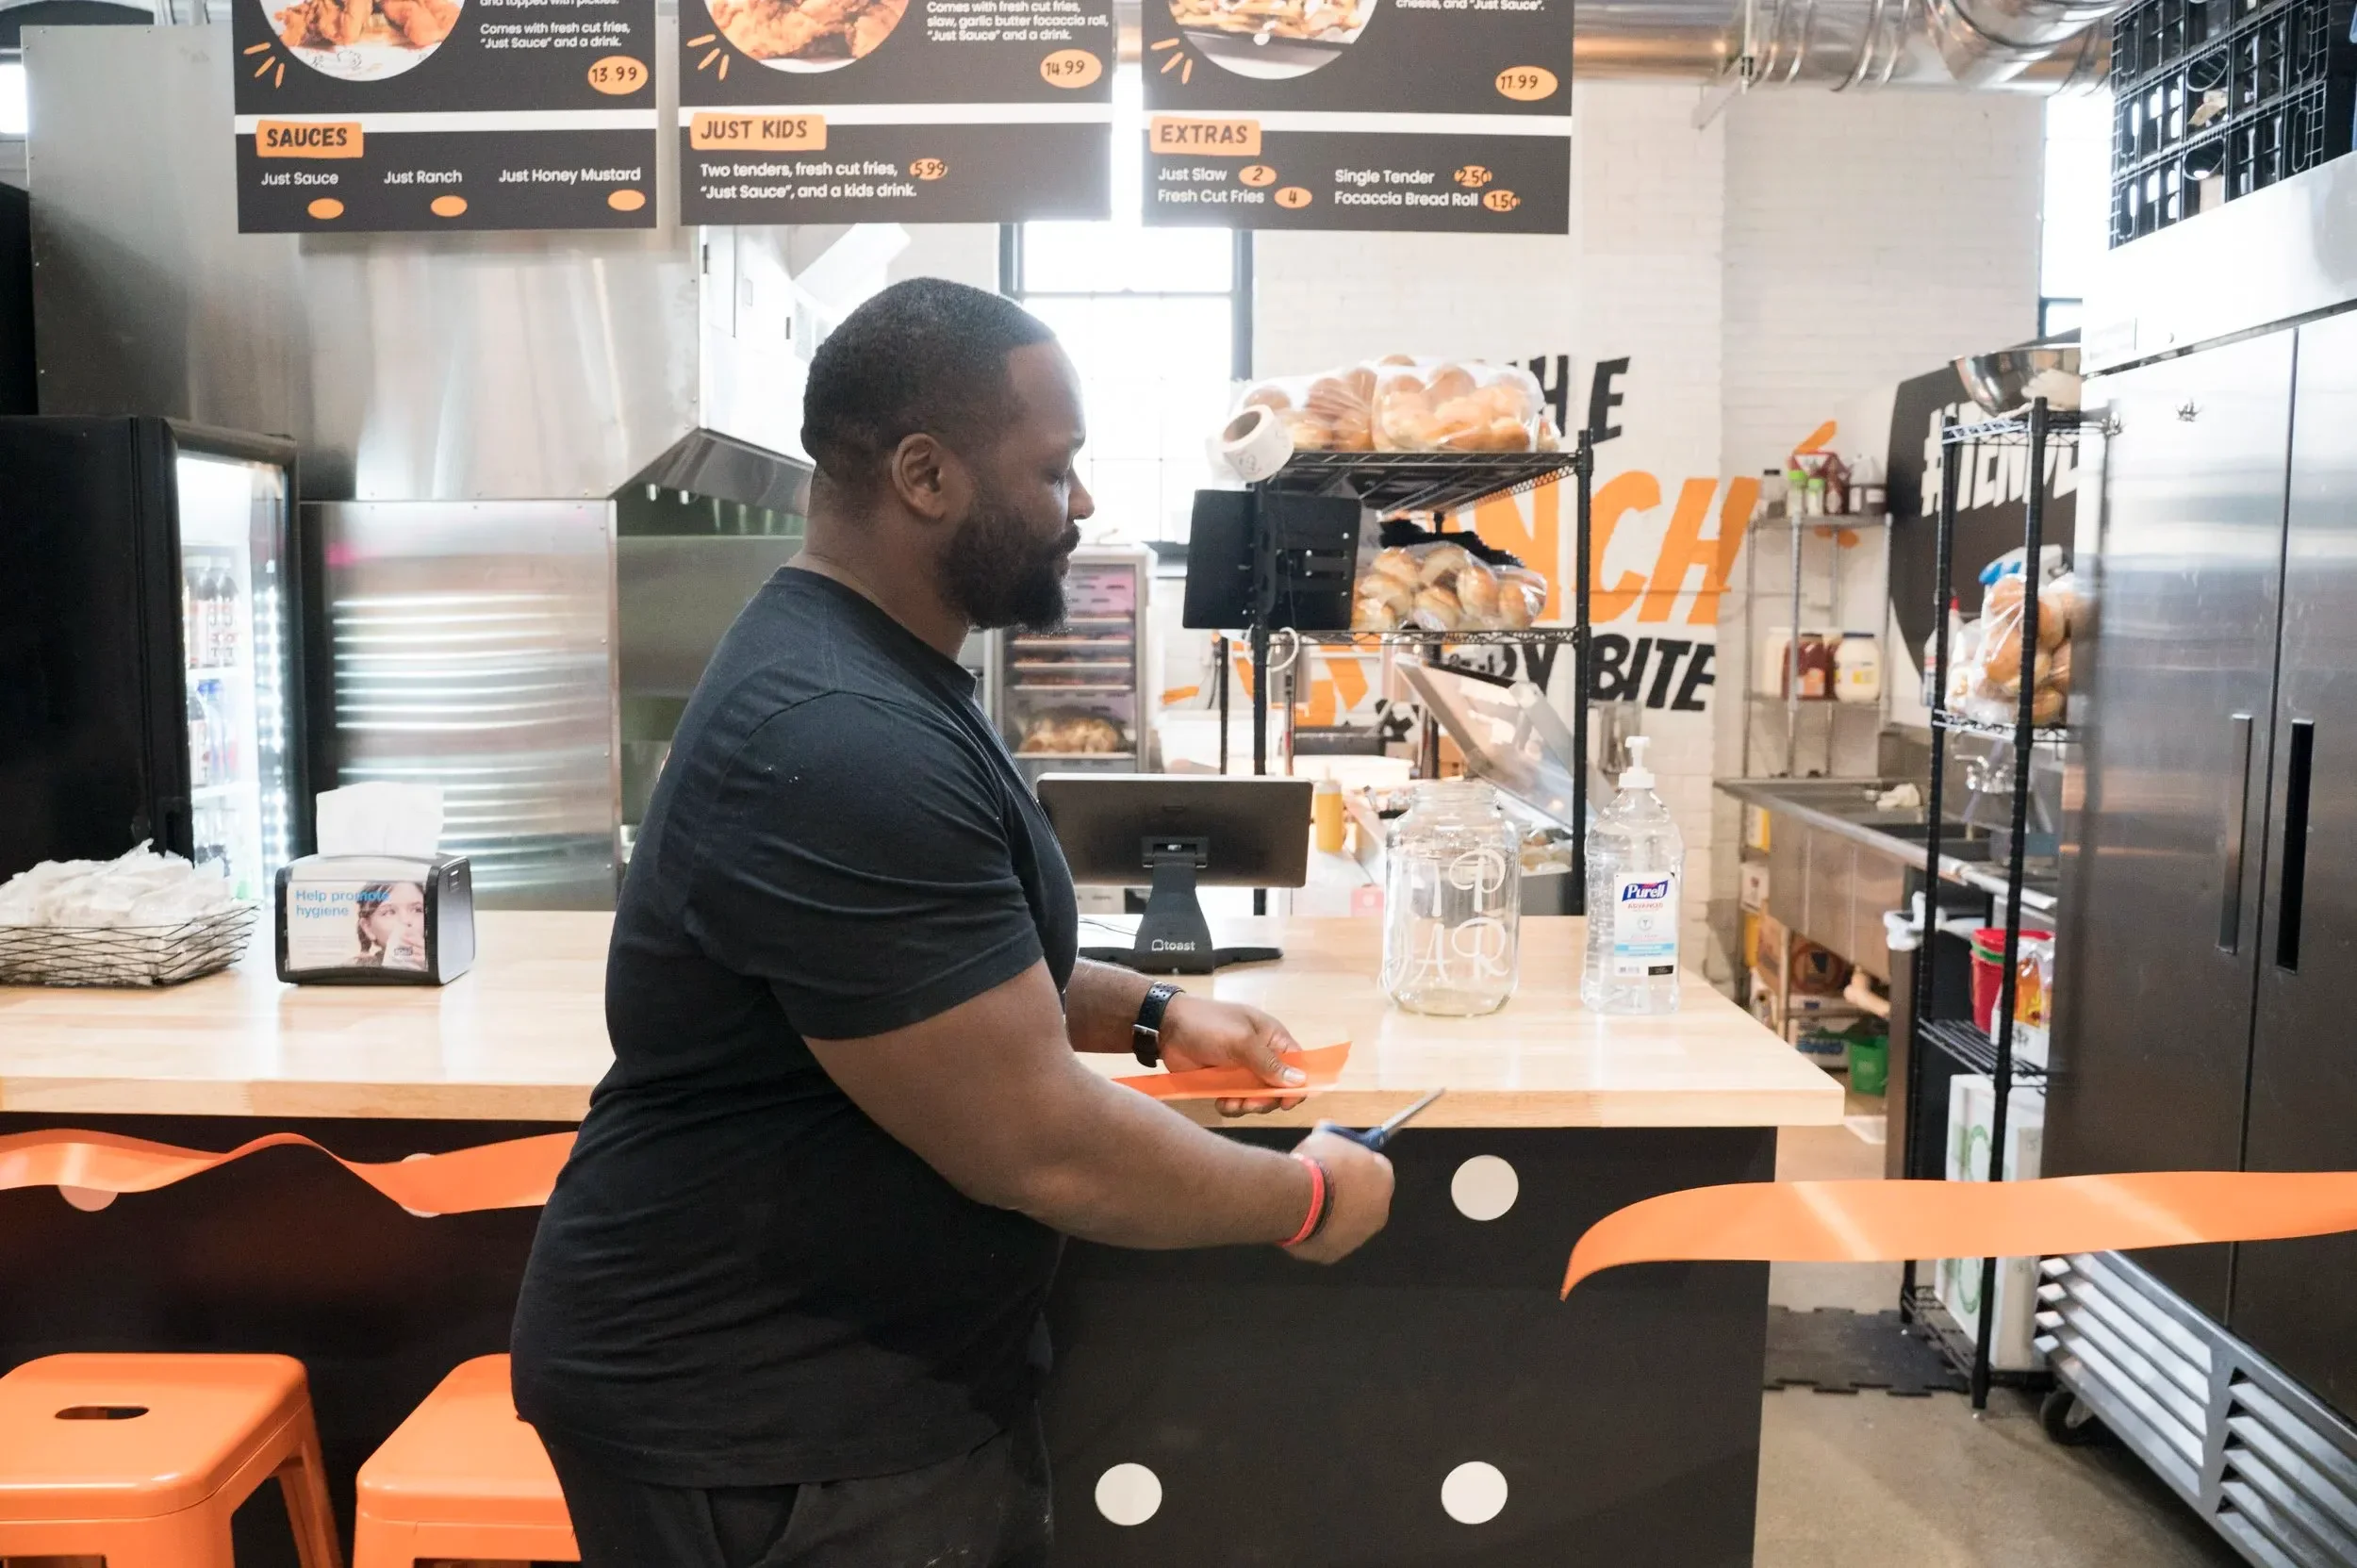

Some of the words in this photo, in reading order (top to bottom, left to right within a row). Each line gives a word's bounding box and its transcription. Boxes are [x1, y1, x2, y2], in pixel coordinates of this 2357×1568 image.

[927, 1, 970, 12] Comes
[972, 1, 997, 12] with
[998, 1, 1029, 12] fresh
[1031, 2, 1051, 12] cut
[1052, 0, 1080, 13] fries,
[1442, 0, 1468, 8] and
[480, 24, 521, 34] Comes
[524, 23, 548, 33] with
[551, 22, 580, 33] fresh
[582, 23, 602, 33] cut
[602, 21, 631, 34] fries,
[927, 16, 957, 27] slaw,
[959, 15, 993, 29] garlic
[995, 15, 1031, 26] butter
[1033, 14, 1086, 26] focaccia
[1087, 14, 1109, 27] roll,
[480, 38, 508, 48] "Just
[511, 37, 552, 48] Sauce"
[554, 36, 577, 47] and
[580, 39, 588, 47] a
[590, 36, 622, 47] drink.
[927, 30, 957, 41] "Just
[959, 29, 1000, 41] Sauce"
[1002, 29, 1027, 41] and
[1029, 32, 1038, 41] a
[1039, 28, 1072, 41] drink.
[592, 66, 637, 83] 13.99
[266, 127, 348, 147] SAUCES
[701, 120, 753, 140] JUST
[762, 120, 808, 139] KIDS
[1161, 124, 1248, 144] EXTRAS
[499, 169, 529, 183] Just
[532, 169, 578, 186] Honey
[581, 167, 641, 182] Mustard
[700, 163, 731, 177] Two
[733, 162, 793, 177] tenders,
[795, 161, 832, 176] fresh
[835, 162, 861, 176] cut
[863, 161, 898, 177] fries,
[1158, 168, 1190, 182] Just
[1192, 167, 1228, 182] Slaw
[1252, 167, 1263, 181] 2
[261, 172, 291, 186] Just
[293, 172, 339, 185] Sauce
[384, 171, 414, 185] Just
[417, 169, 463, 184] Ranch
[1334, 169, 1380, 187] Single
[1383, 170, 1435, 184] Tender
[700, 185, 738, 199] "Just
[740, 184, 796, 200] Sauce",
[798, 184, 829, 198] and
[830, 187, 842, 198] a
[844, 183, 874, 198] kids
[877, 183, 917, 197] drink.
[1158, 190, 1197, 204] Fresh
[1200, 190, 1229, 203] Cut
[1229, 190, 1265, 204] Fries
[1288, 190, 1297, 205] 4
[1334, 191, 1403, 206] Focaccia
[1405, 191, 1449, 206] Bread
[1452, 192, 1478, 206] Roll
[1507, 355, 1631, 444] HE
[1589, 633, 1717, 711] BITE
[295, 890, 327, 902] Help
[331, 890, 390, 902] promote
[1627, 883, 1665, 899] Purell
[295, 904, 349, 920] hygiene
[1164, 941, 1195, 951] toast
